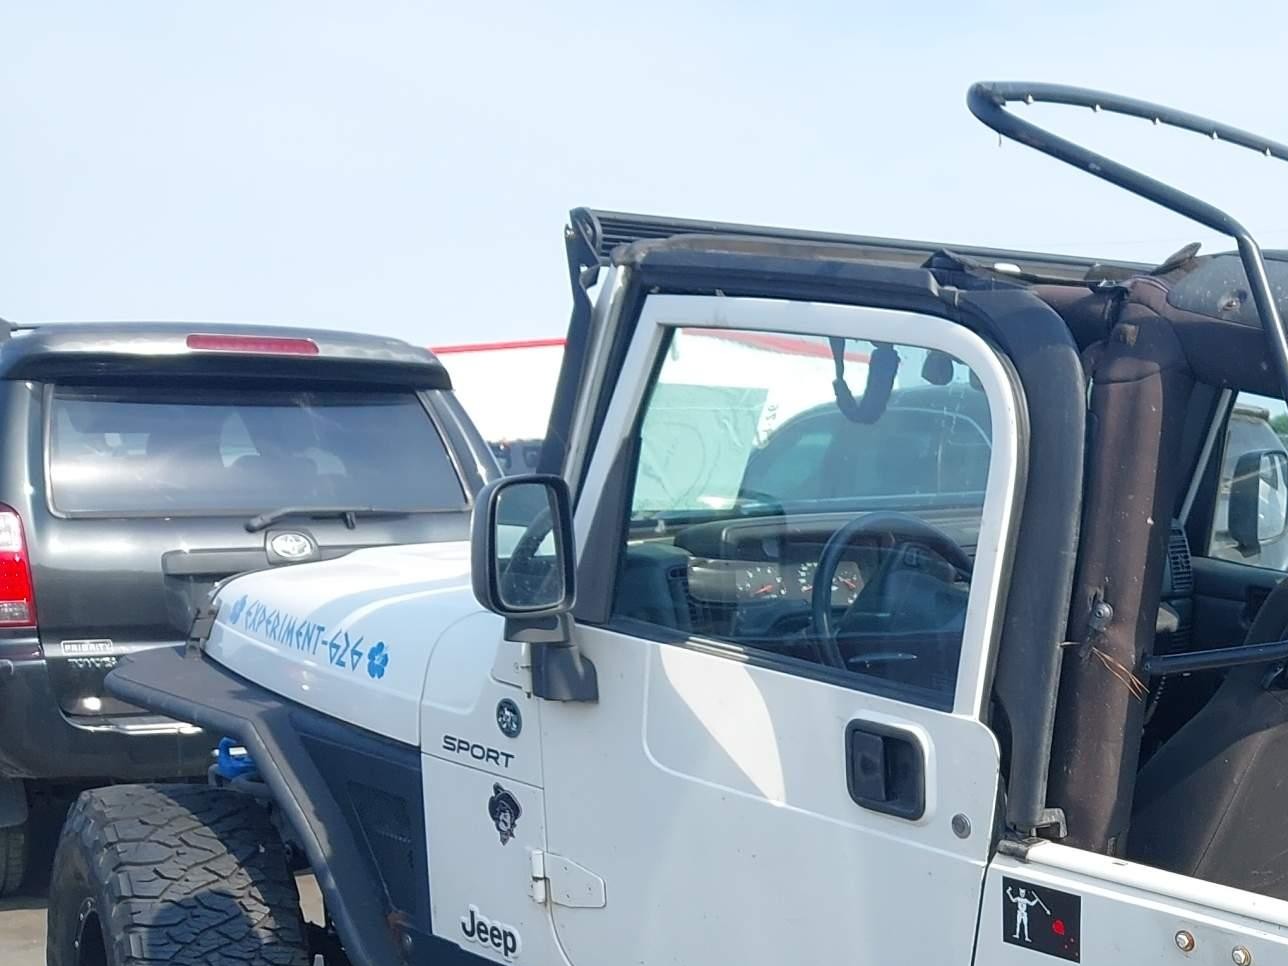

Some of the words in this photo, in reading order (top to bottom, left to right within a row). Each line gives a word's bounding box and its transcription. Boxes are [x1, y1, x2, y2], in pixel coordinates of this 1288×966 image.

[245, 600, 364, 671] EXPERIMENT-626
[442, 735, 515, 768] SPORT
[461, 908, 517, 957] Jeep
